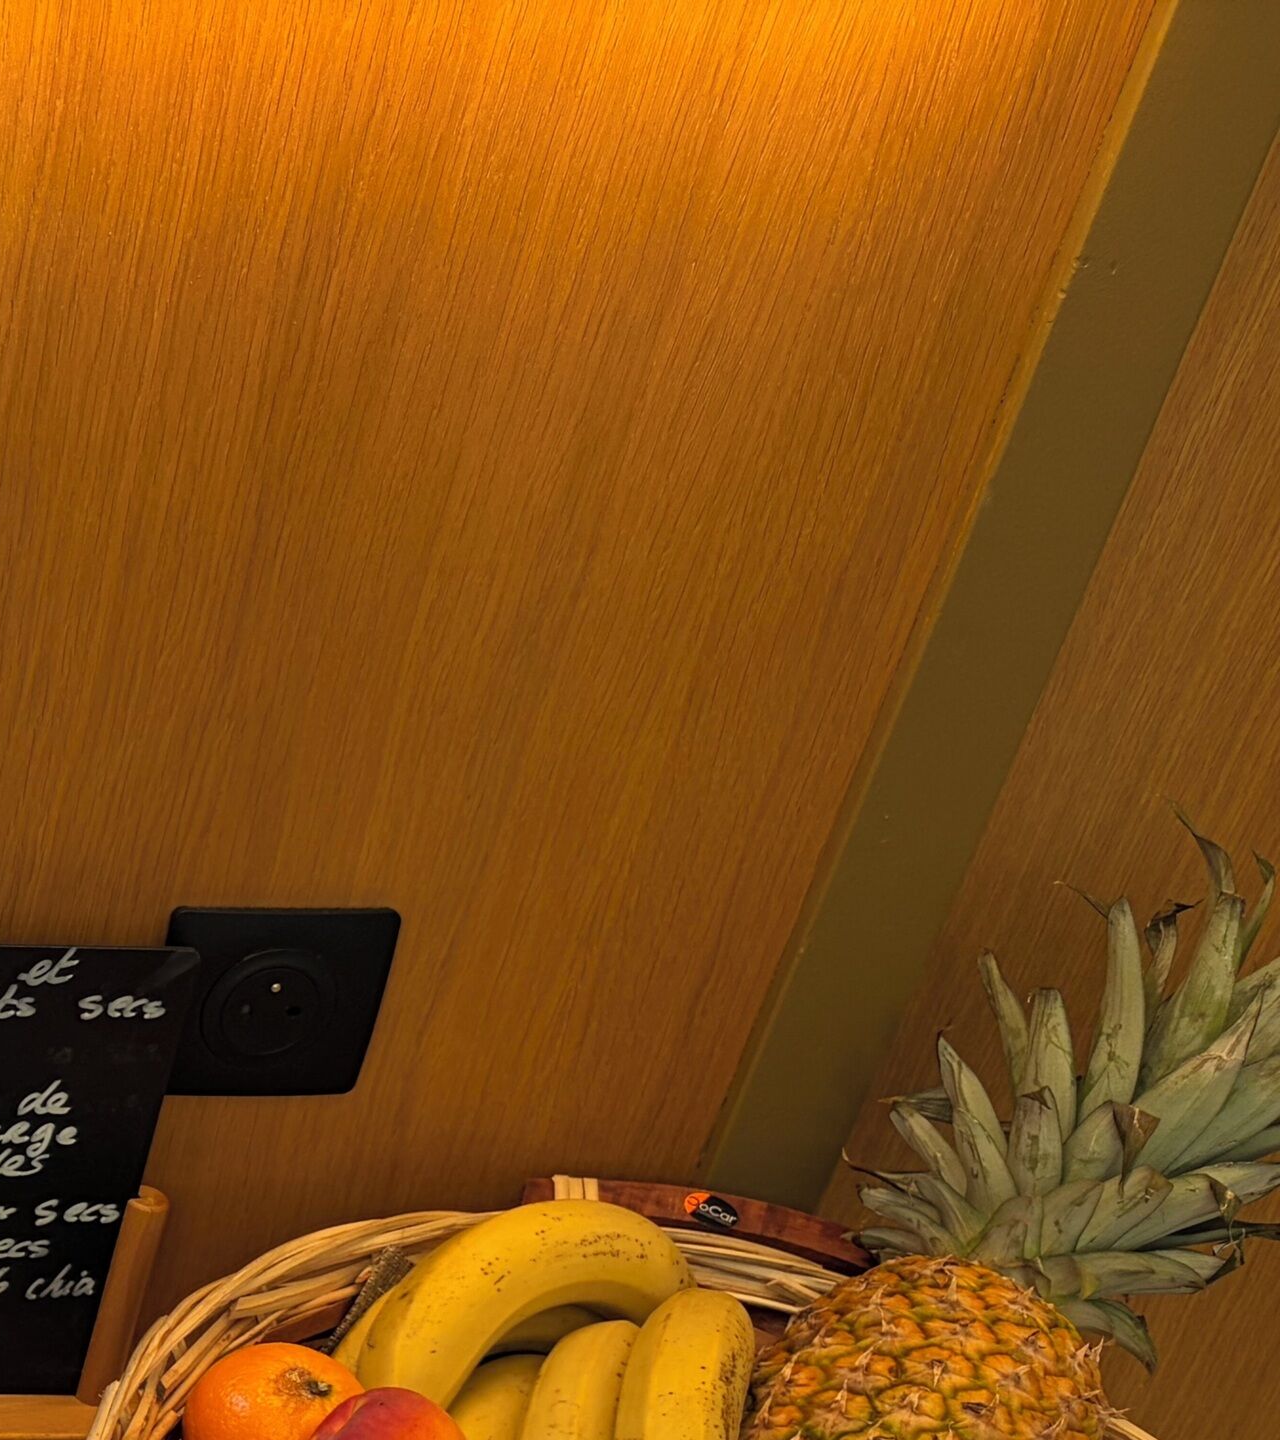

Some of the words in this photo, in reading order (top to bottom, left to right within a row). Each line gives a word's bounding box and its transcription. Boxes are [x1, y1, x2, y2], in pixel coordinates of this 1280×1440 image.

[17, 947, 79, 987] et
[77, 993, 167, 1021] secs
[17, 1079, 72, 1117] de
[25, 1264, 97, 1300] chia
